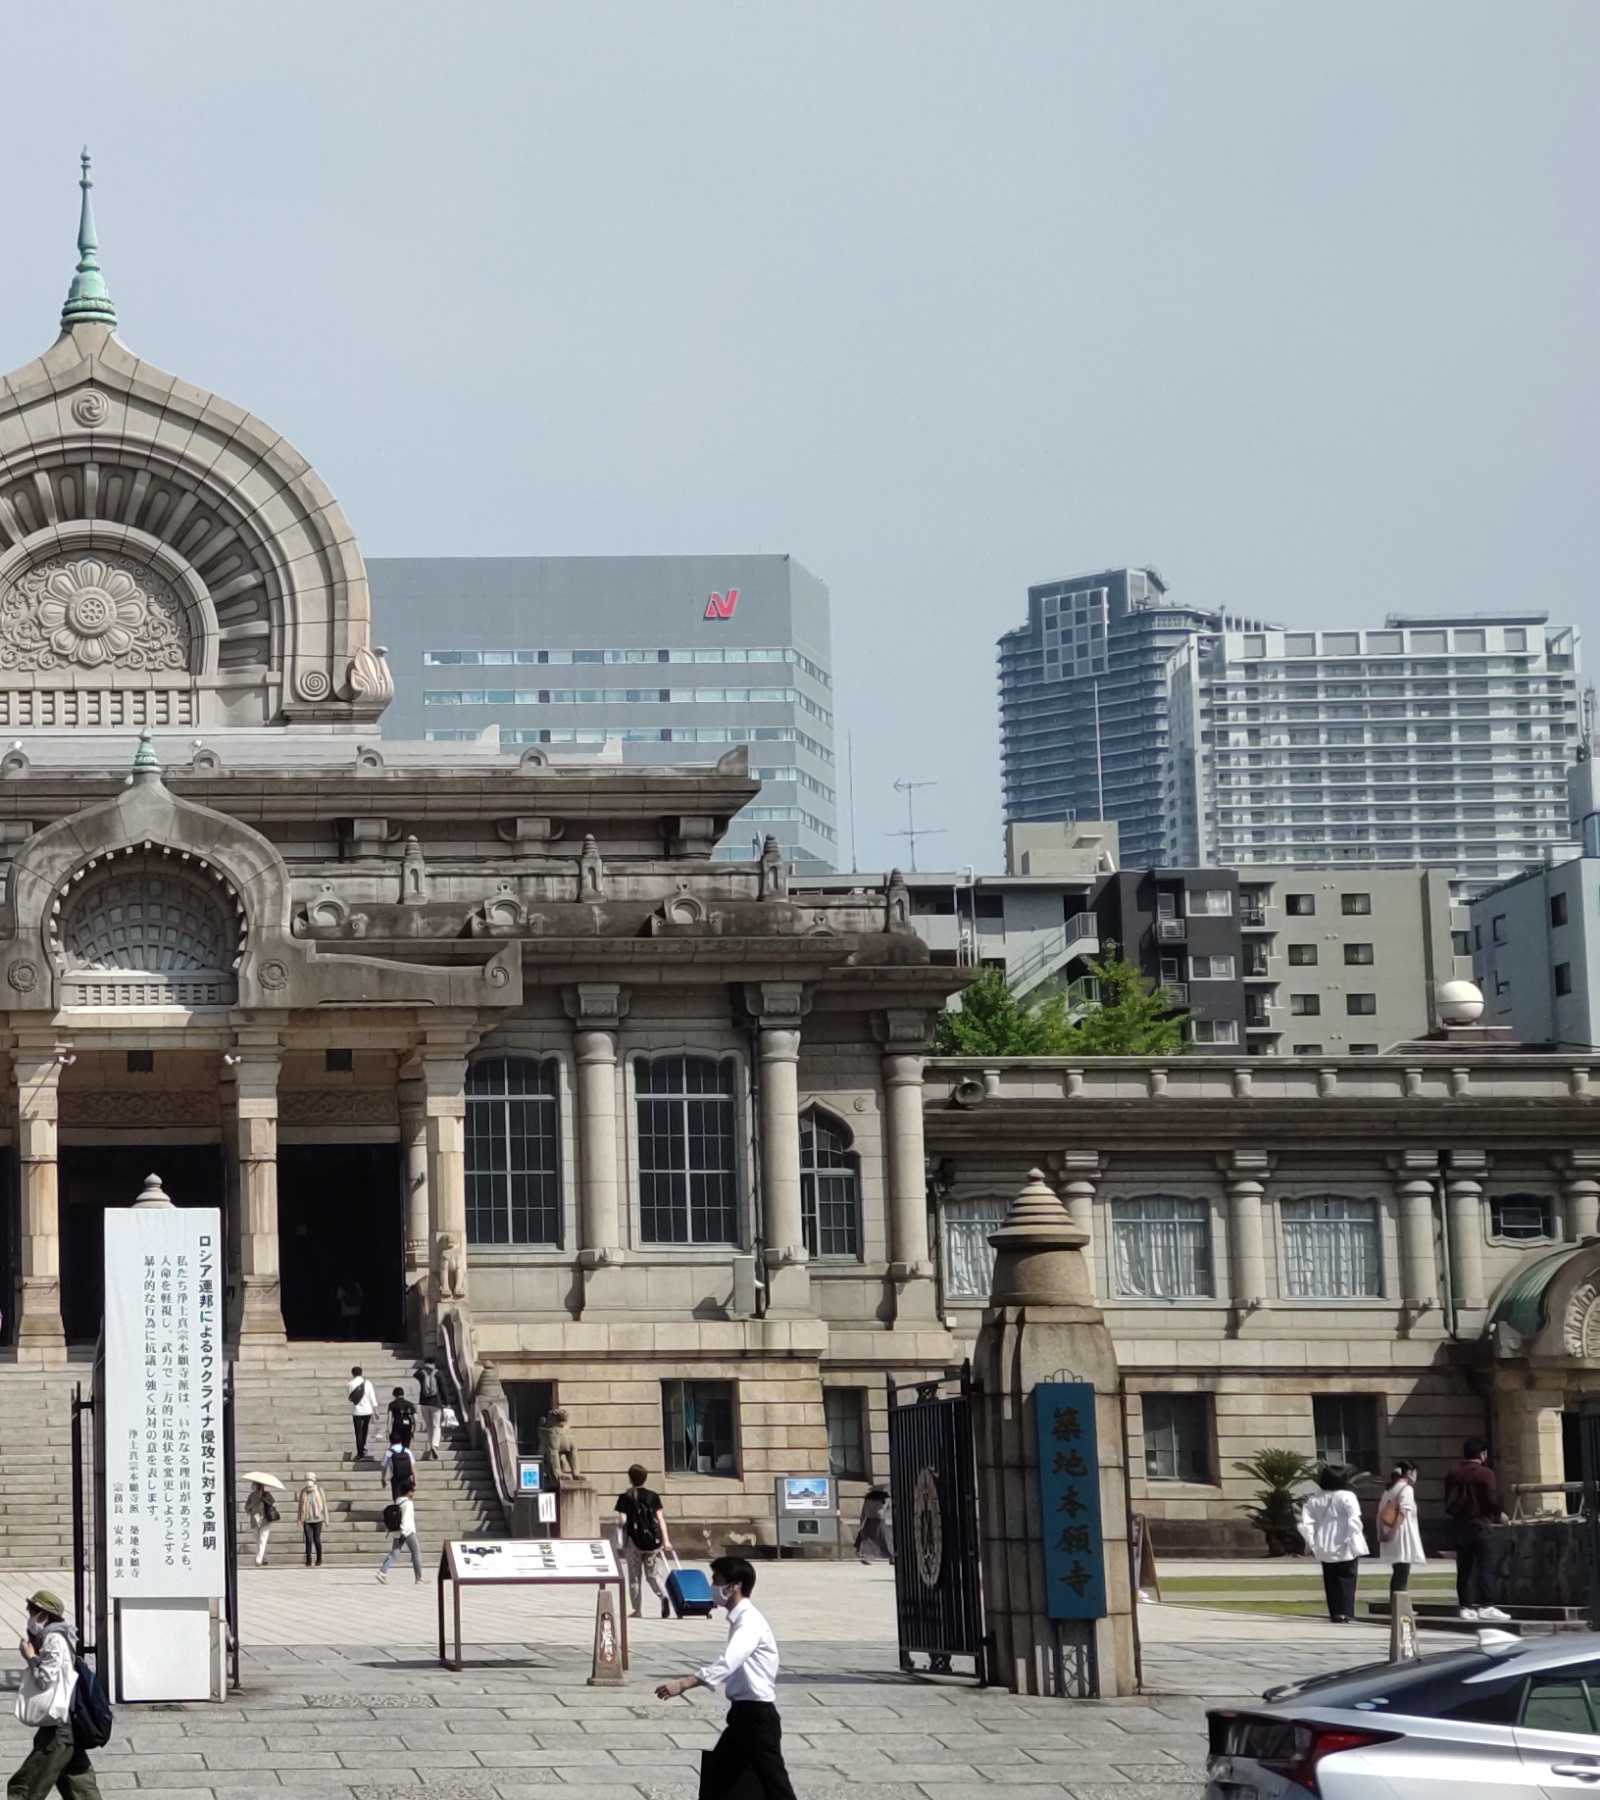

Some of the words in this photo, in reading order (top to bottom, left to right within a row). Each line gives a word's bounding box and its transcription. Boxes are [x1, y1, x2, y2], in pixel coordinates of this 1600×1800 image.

[199, 1235, 217, 1550] ロシア連邦によるウクライナ侵攻に対する声明
[1052, 1405, 1093, 1599] 築地本願寺
